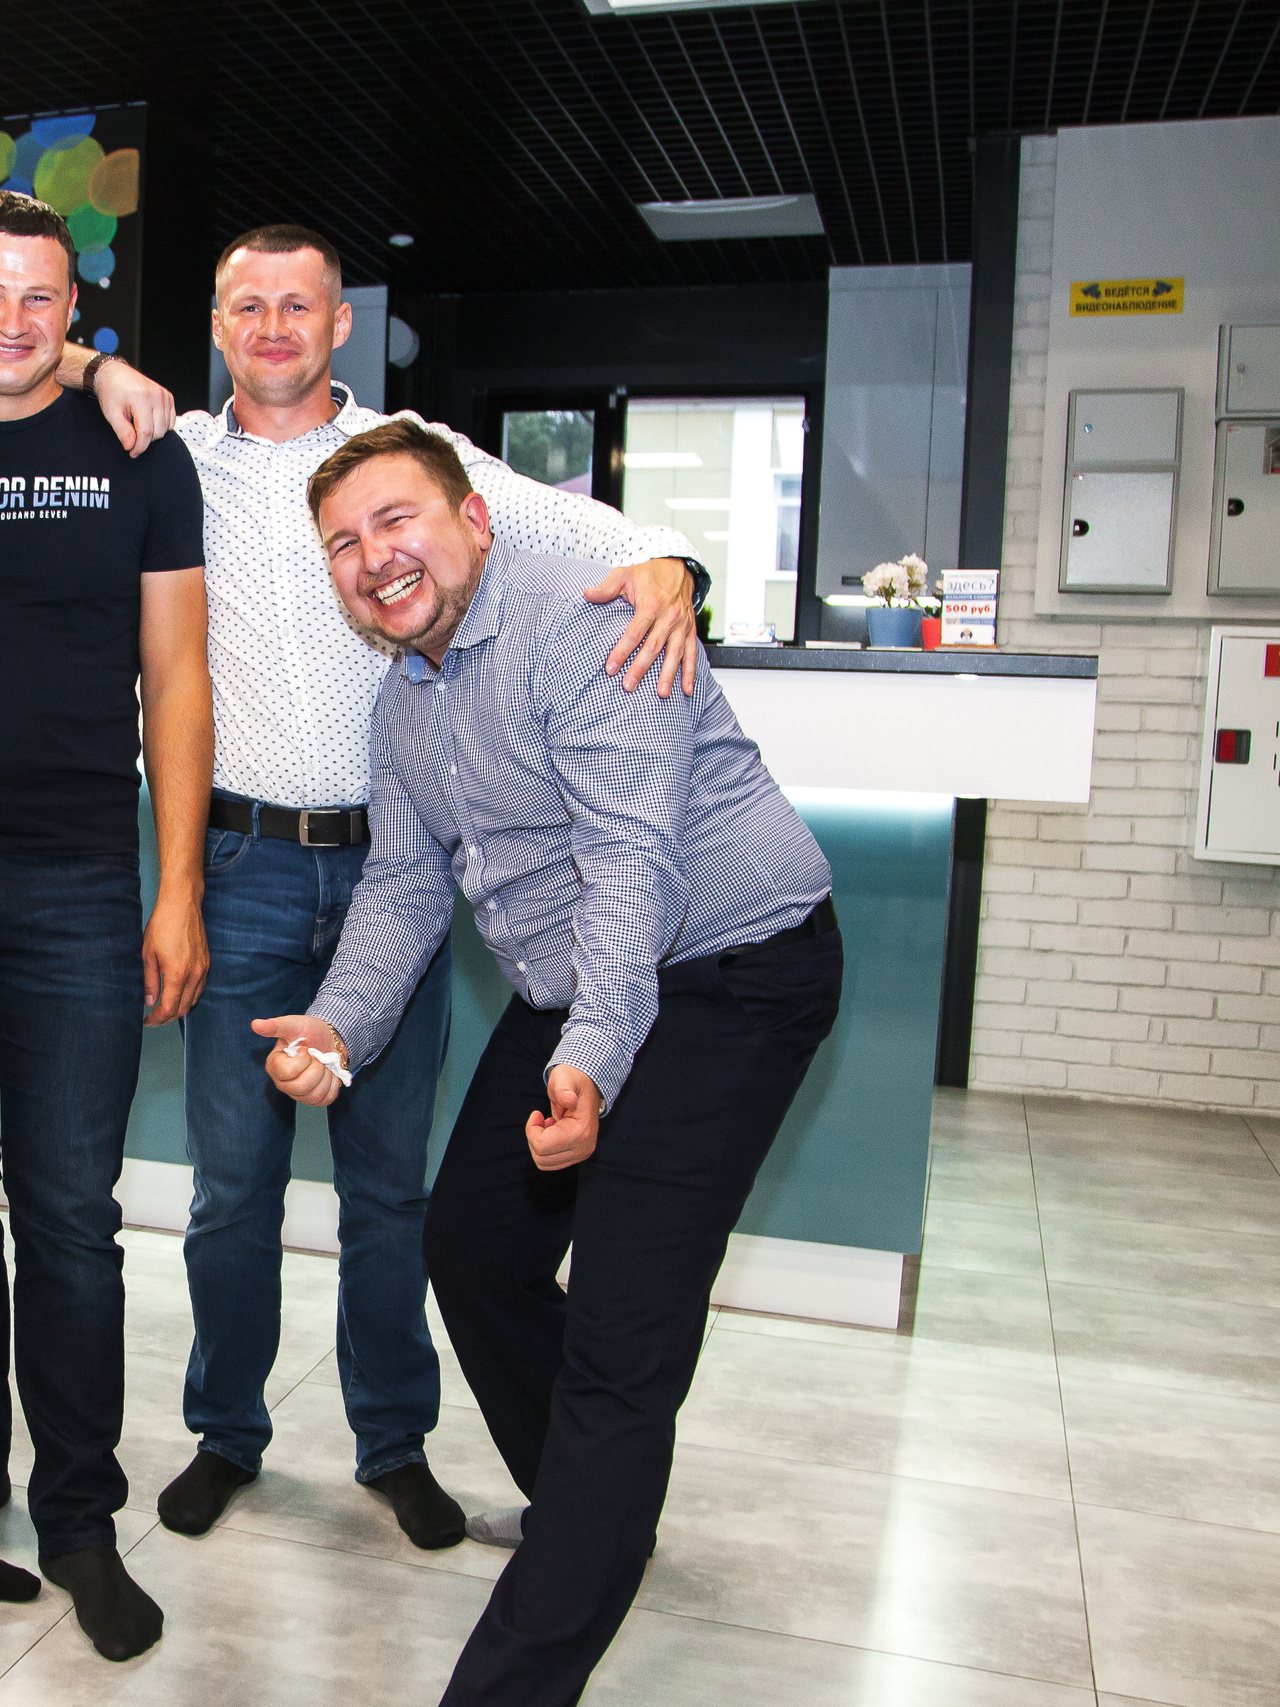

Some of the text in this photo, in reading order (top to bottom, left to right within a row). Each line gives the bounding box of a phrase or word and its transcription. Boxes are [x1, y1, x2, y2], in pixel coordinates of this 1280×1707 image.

[1104, 285, 1150, 298] ВЕДЁТСЯ
[1075, 299, 1178, 313] ВИДЕОНАБЛЮДЕНИЕ
[32, 475, 110, 510] DENIM
[39, 509, 68, 519] SEVEN
[945, 604, 994, 615] 500 руб.
